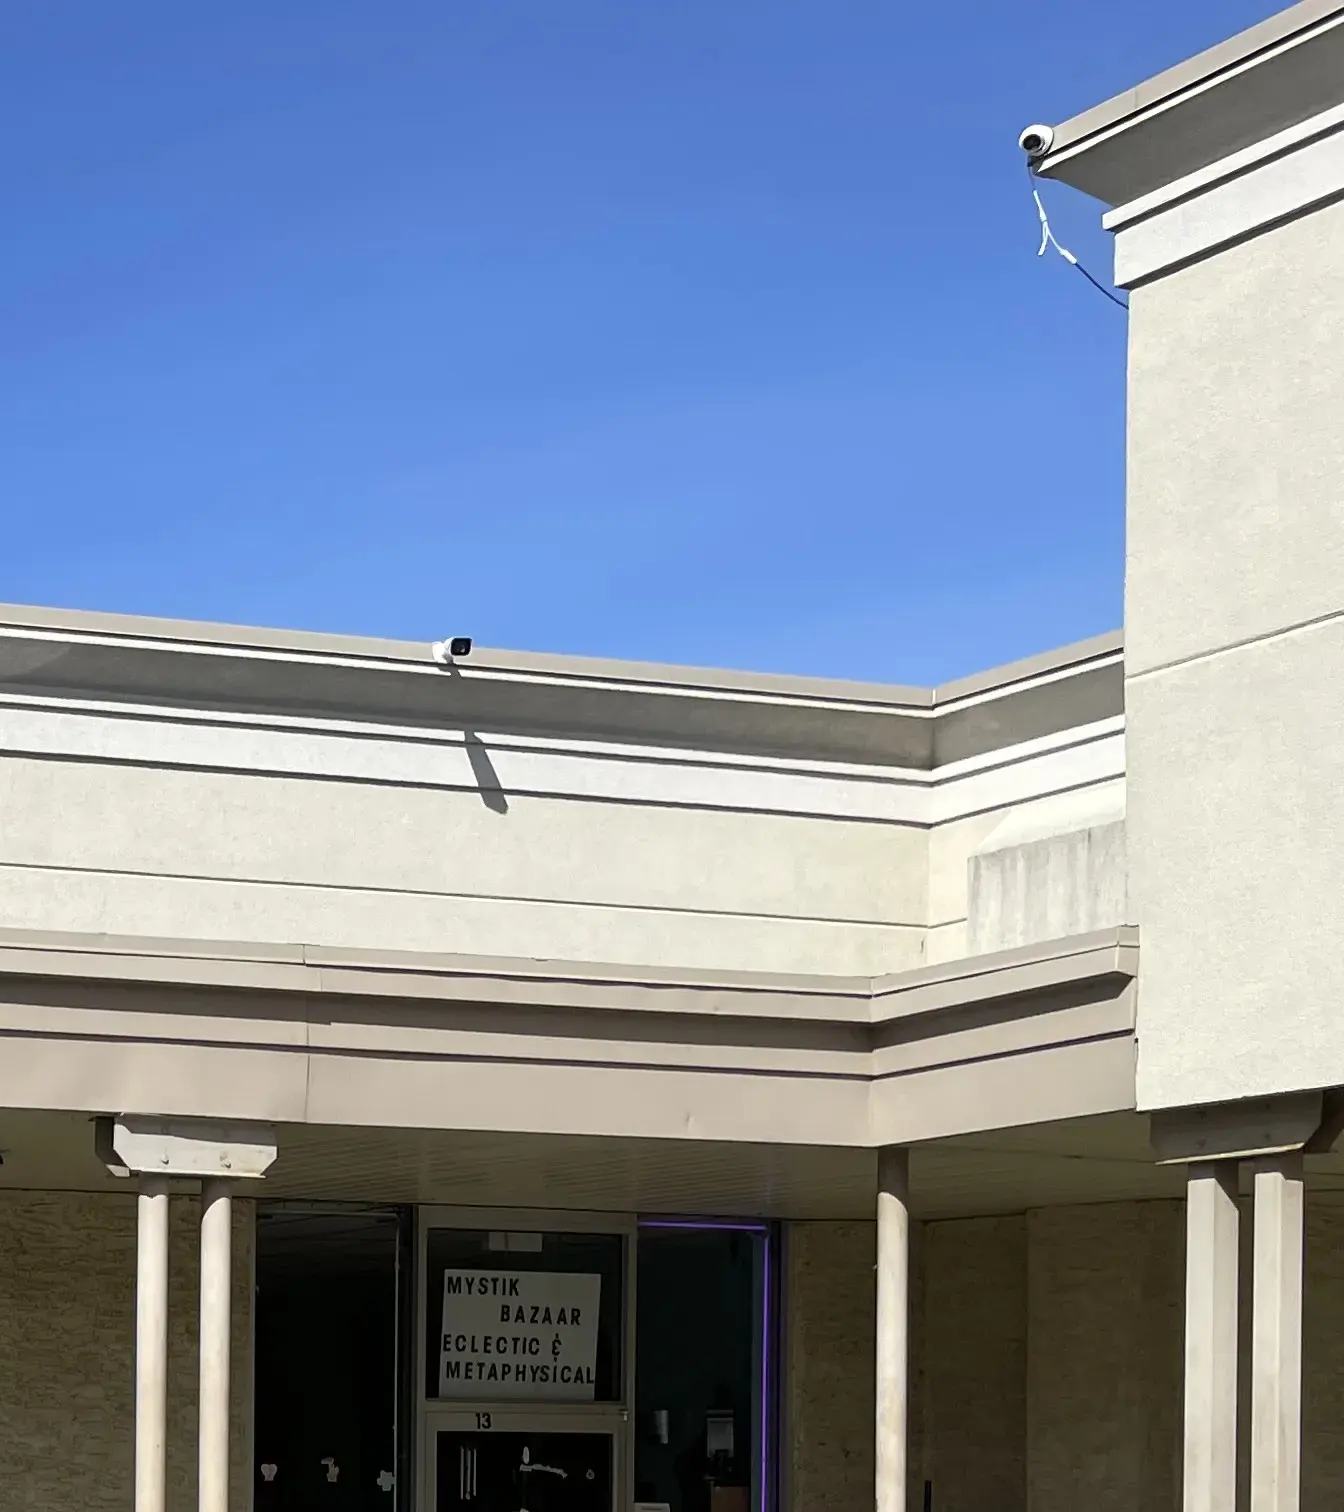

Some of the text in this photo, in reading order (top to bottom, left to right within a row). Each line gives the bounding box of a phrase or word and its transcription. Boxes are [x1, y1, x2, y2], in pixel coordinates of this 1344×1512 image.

[447, 1276, 520, 1296] MYSTIK
[500, 1305, 581, 1325] BAZAAR
[443, 1334, 540, 1355] ECLECTIC
[446, 1361, 594, 1384] METAPHYSICAL
[476, 1412, 492, 1430] 13
